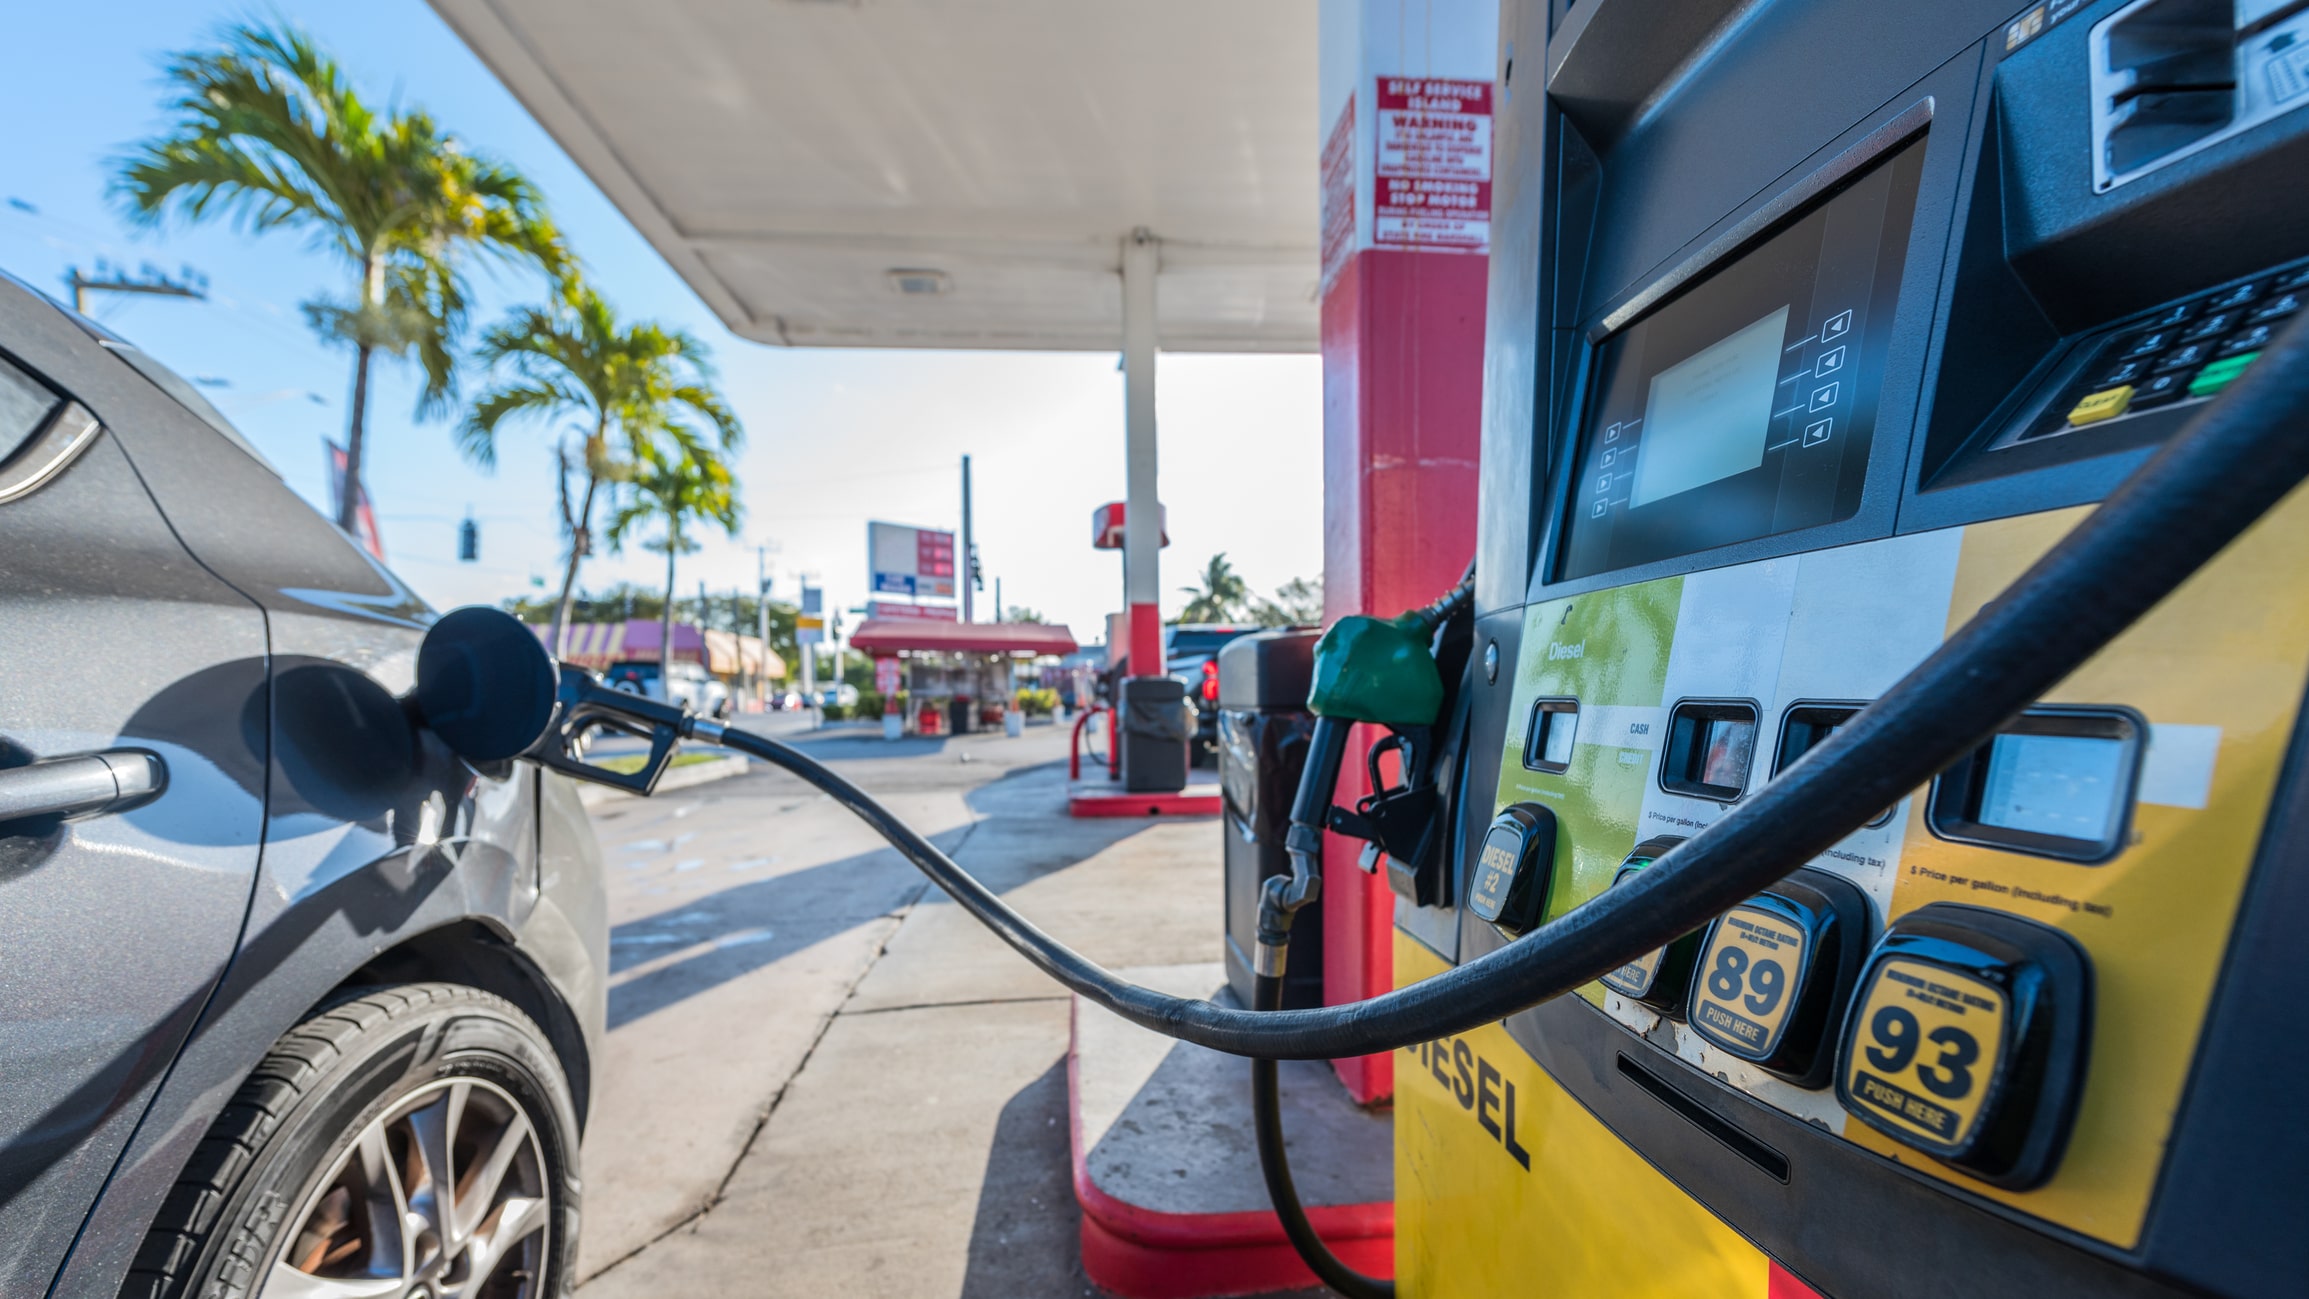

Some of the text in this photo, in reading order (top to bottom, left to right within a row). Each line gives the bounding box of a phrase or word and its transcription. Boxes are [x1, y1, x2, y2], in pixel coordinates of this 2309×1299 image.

[1424, 81, 1482, 100] SERVICE
[1408, 98, 1462, 112] ISLAND
[1393, 117, 1477, 132] WARNING
[1388, 179, 1479, 196] NO SMOKING
[1389, 192, 1477, 209] STOP MOTOR
[1549, 640, 1586, 660] Diesel
[1630, 723, 1649, 735] CASH
[1618, 751, 1644, 765] CREDIT
[1652, 812, 1667, 822] Price
[1676, 818, 1694, 828] gallon
[1482, 844, 1516, 876] DIESEL
[1484, 871, 1500, 894] #2
[1919, 866, 1947, 882] Price
[1949, 873, 1969, 886] per
[1971, 878, 2009, 894] gallon
[1754, 924, 1777, 940] OCTANE
[1708, 945, 1785, 1017] 89
[1706, 1006, 1760, 1042] PUSH HERE
[1865, 1005, 1981, 1102] 93
[1405, 1036, 1530, 1174] ESEL
[1863, 1079, 1947, 1131] PUSH HERE
